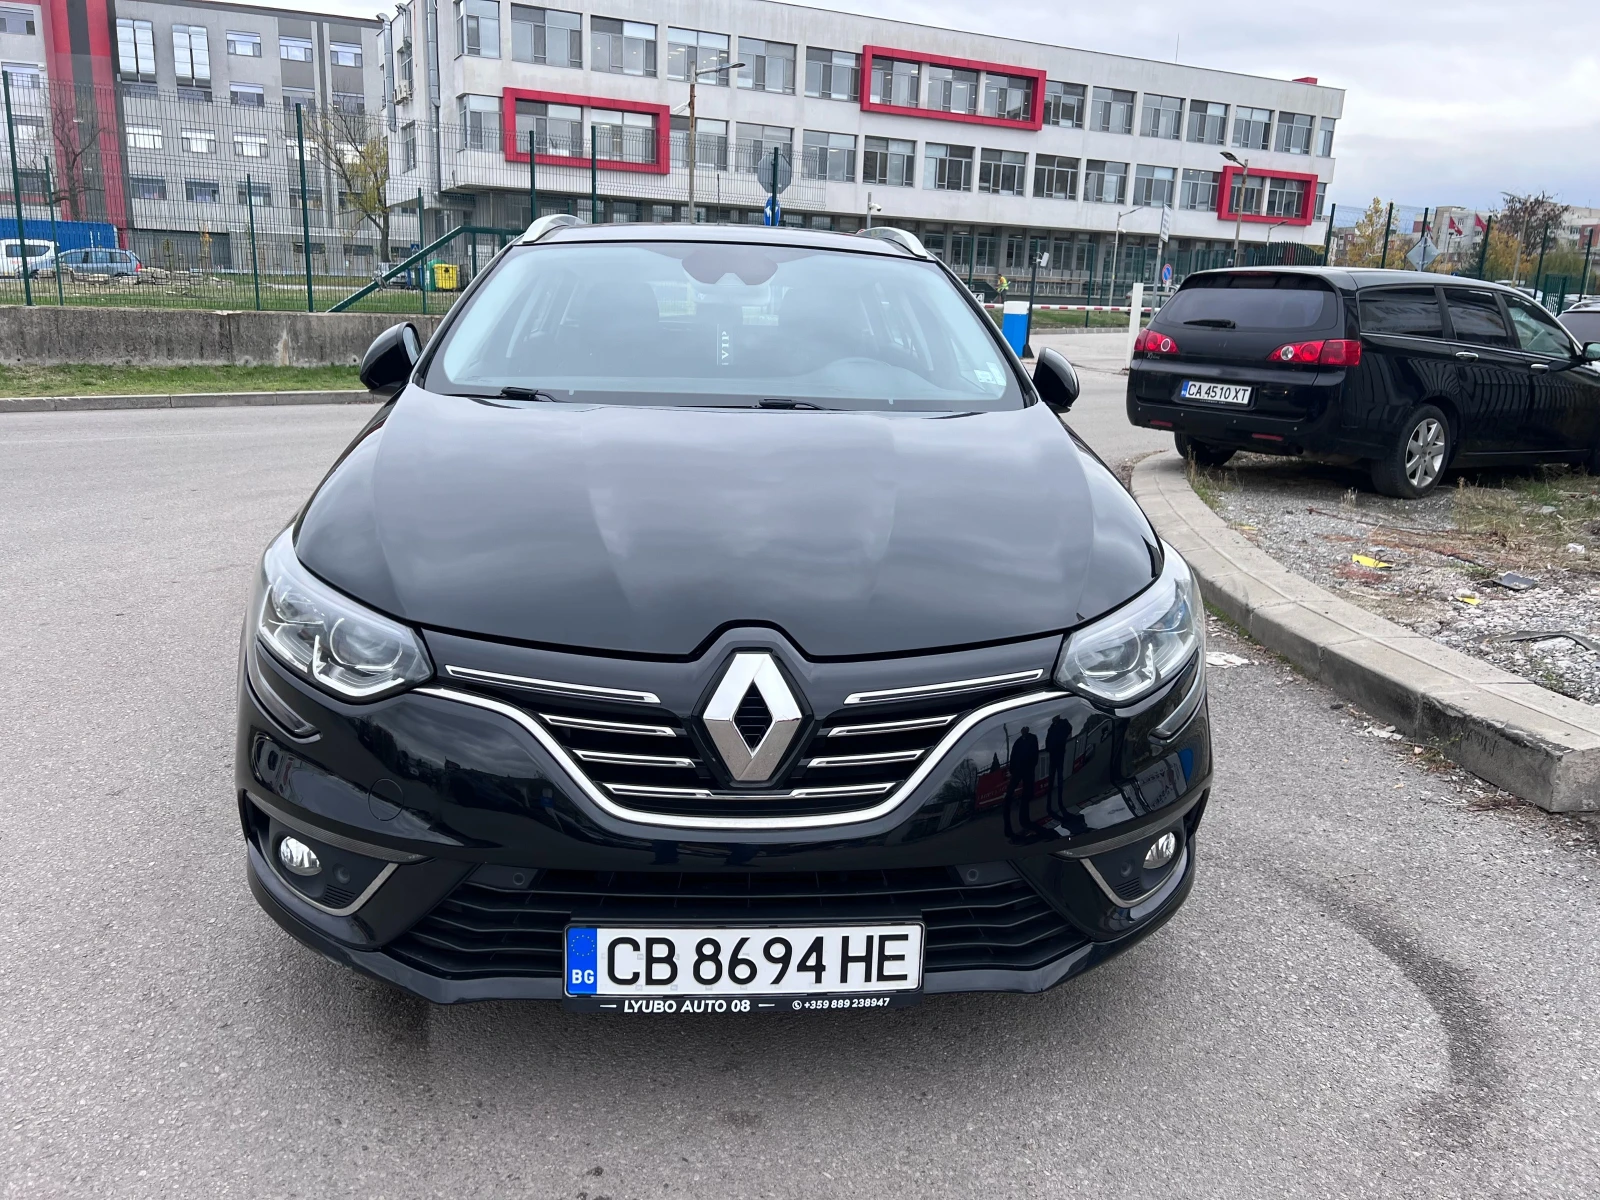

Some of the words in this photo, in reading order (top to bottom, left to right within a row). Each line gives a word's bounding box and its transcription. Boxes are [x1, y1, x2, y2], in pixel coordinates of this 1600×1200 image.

[1187, 383, 1202, 397] CA
[1204, 385, 1231, 400] 4510
[1232, 387, 1249, 402] XT
[607, 936, 678, 986] CB
[692, 936, 826, 986] 8694
[840, 933, 909, 984] HE
[571, 969, 595, 985] BG
[623, 999, 677, 1013] LYUBO
[680, 999, 727, 1013] AUTO
[730, 999, 751, 1013] 08
[804, 999, 830, 1009] +359
[830, 998, 851, 1009] 889
[851, 997, 890, 1008] 238947
